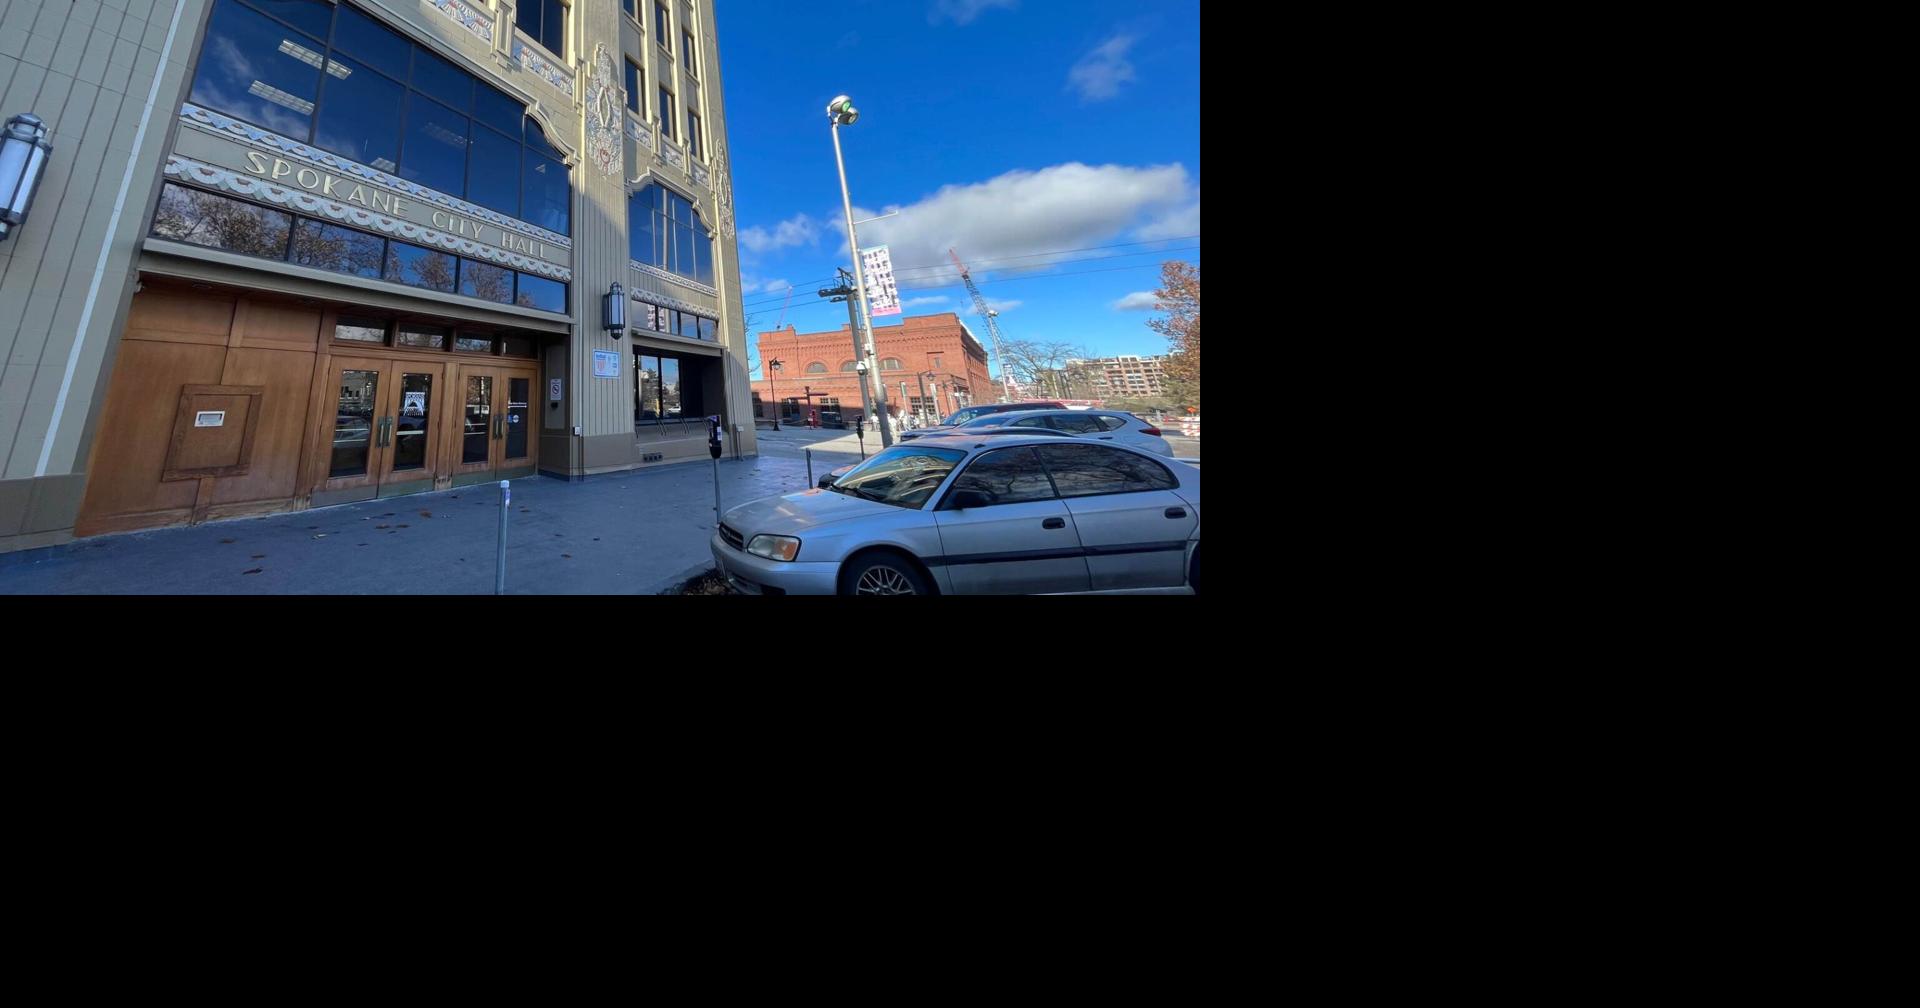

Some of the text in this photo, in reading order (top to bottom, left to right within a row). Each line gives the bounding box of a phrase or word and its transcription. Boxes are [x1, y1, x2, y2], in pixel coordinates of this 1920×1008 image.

[244, 151, 548, 259] SPOKANE CITY HALL
